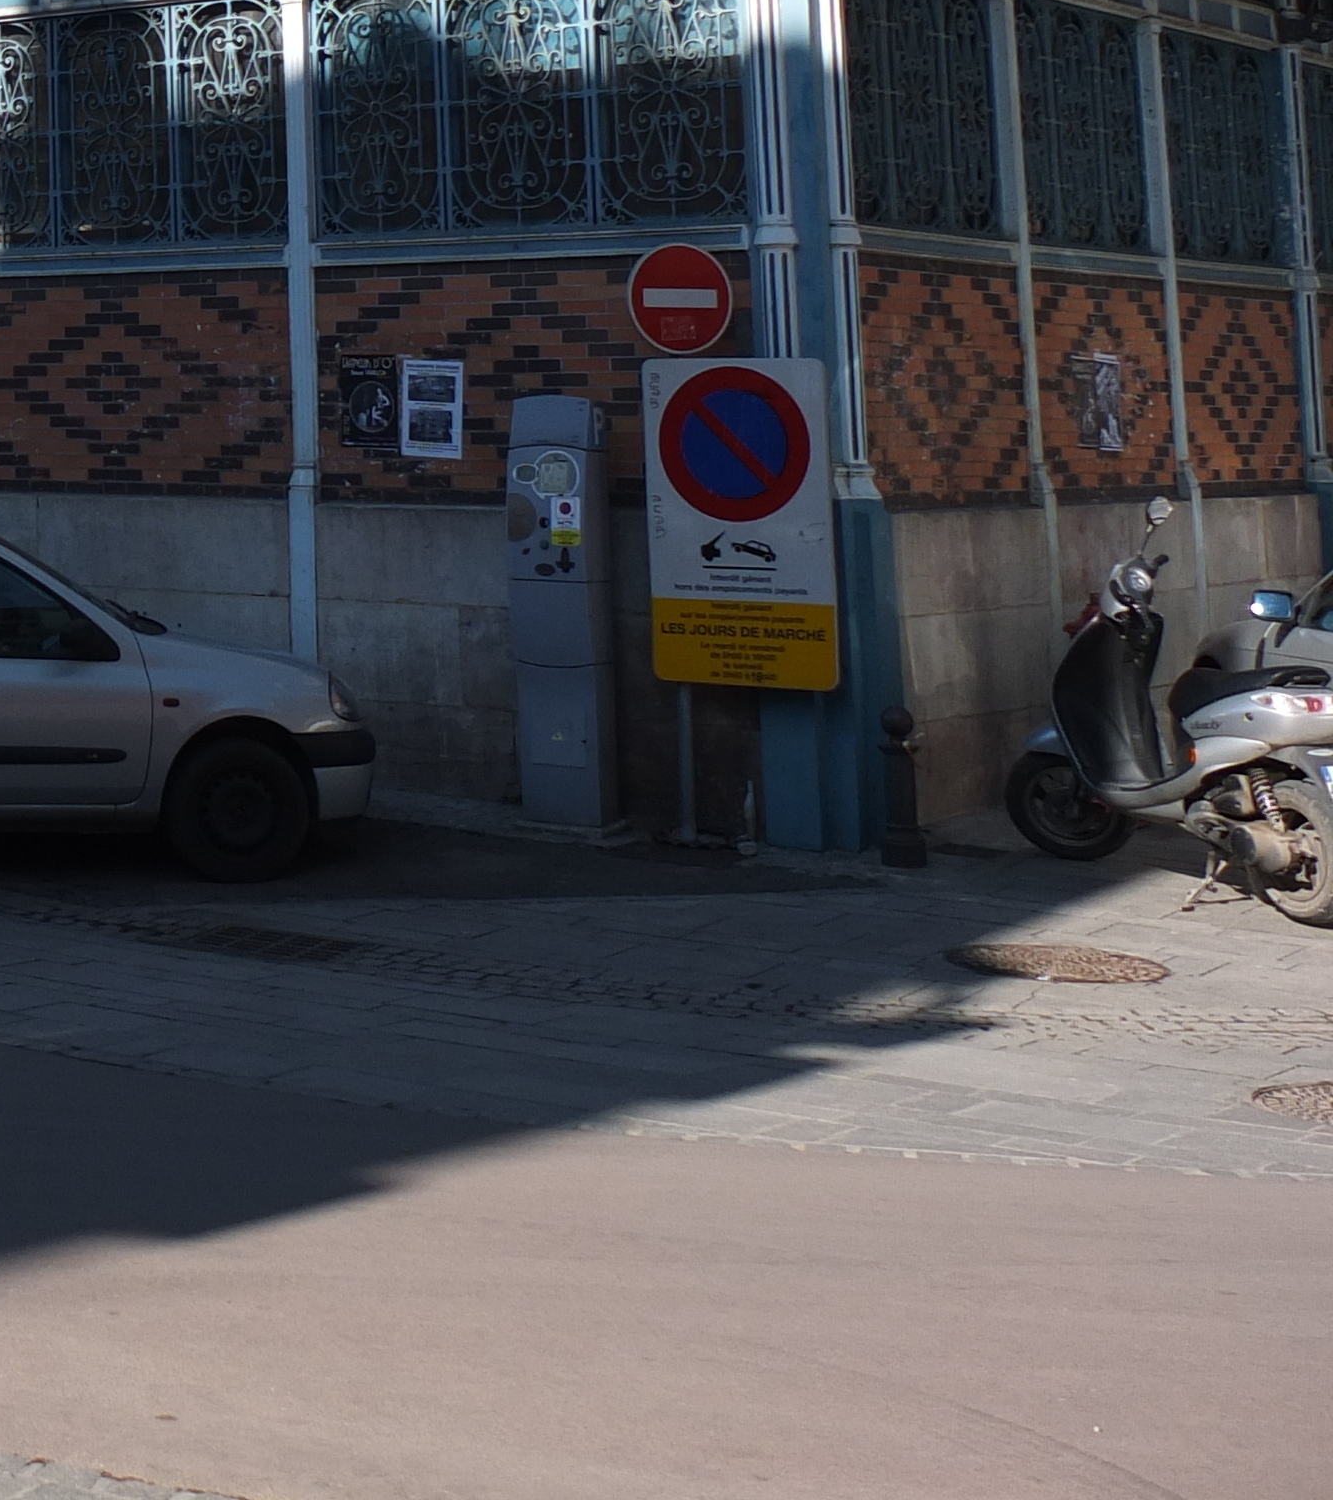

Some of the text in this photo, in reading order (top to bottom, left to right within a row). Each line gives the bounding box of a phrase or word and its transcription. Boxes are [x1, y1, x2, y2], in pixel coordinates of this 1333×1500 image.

[661, 622, 826, 641] LES JOURS DE MARCHÉ
